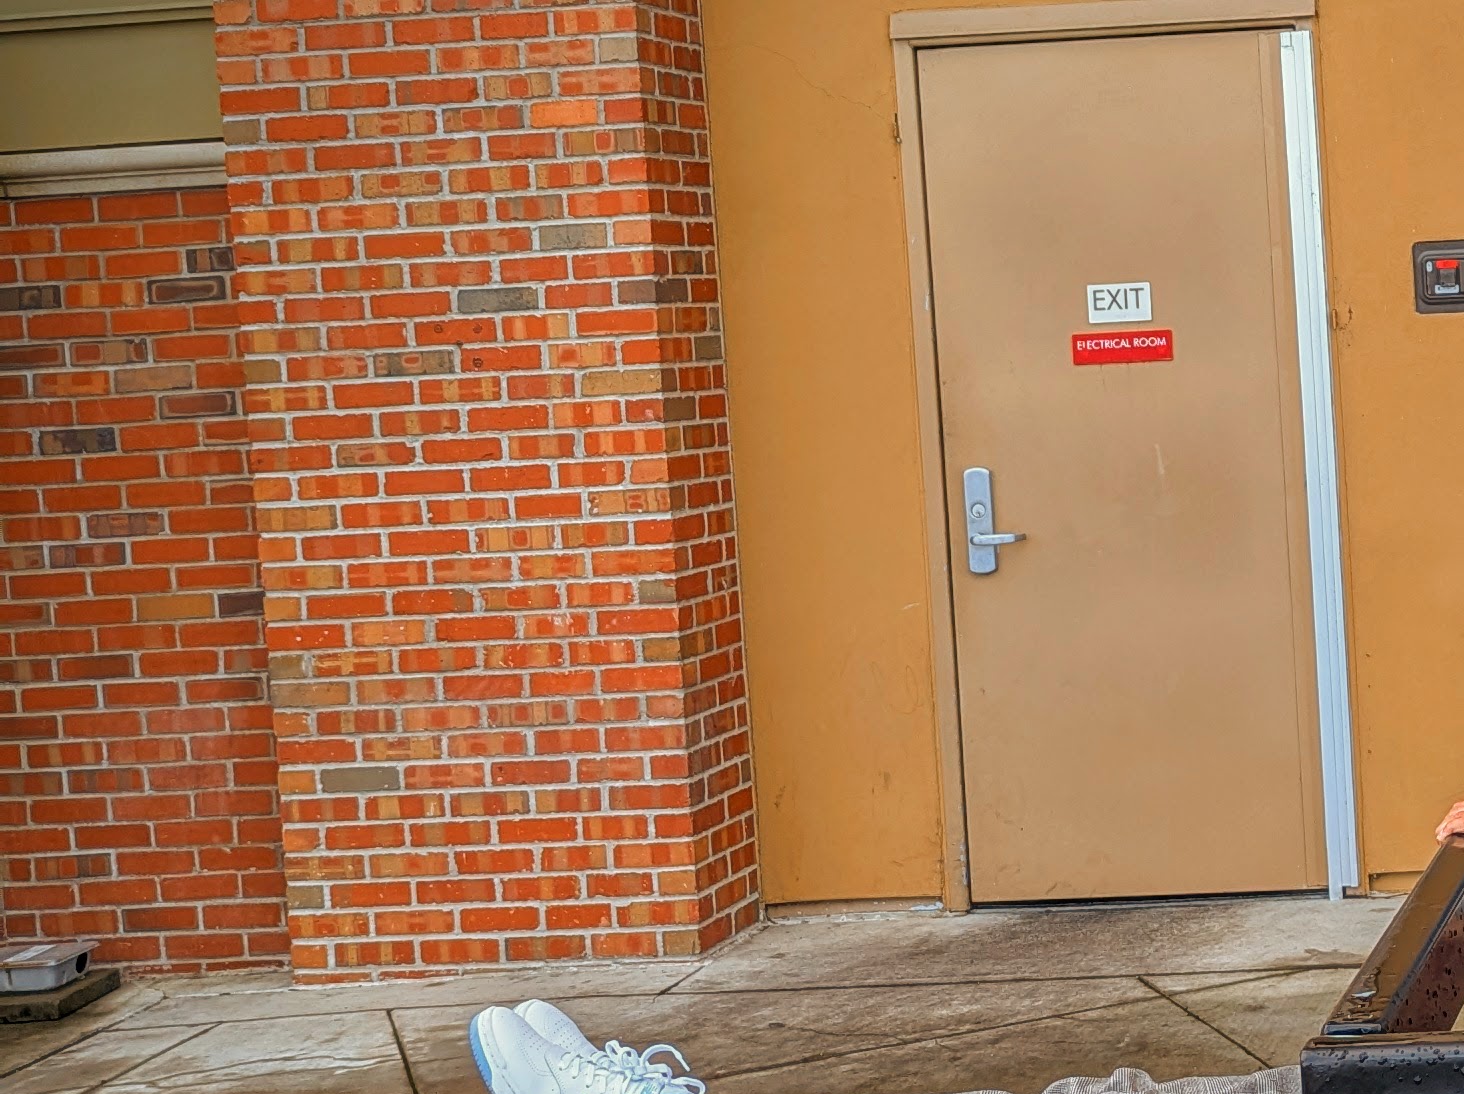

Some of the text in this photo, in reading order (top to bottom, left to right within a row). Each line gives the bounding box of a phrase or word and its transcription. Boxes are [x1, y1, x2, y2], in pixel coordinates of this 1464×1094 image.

[1093, 288, 1144, 311] EXIT
[1077, 337, 1166, 350] ELECTRICAL ROOM
